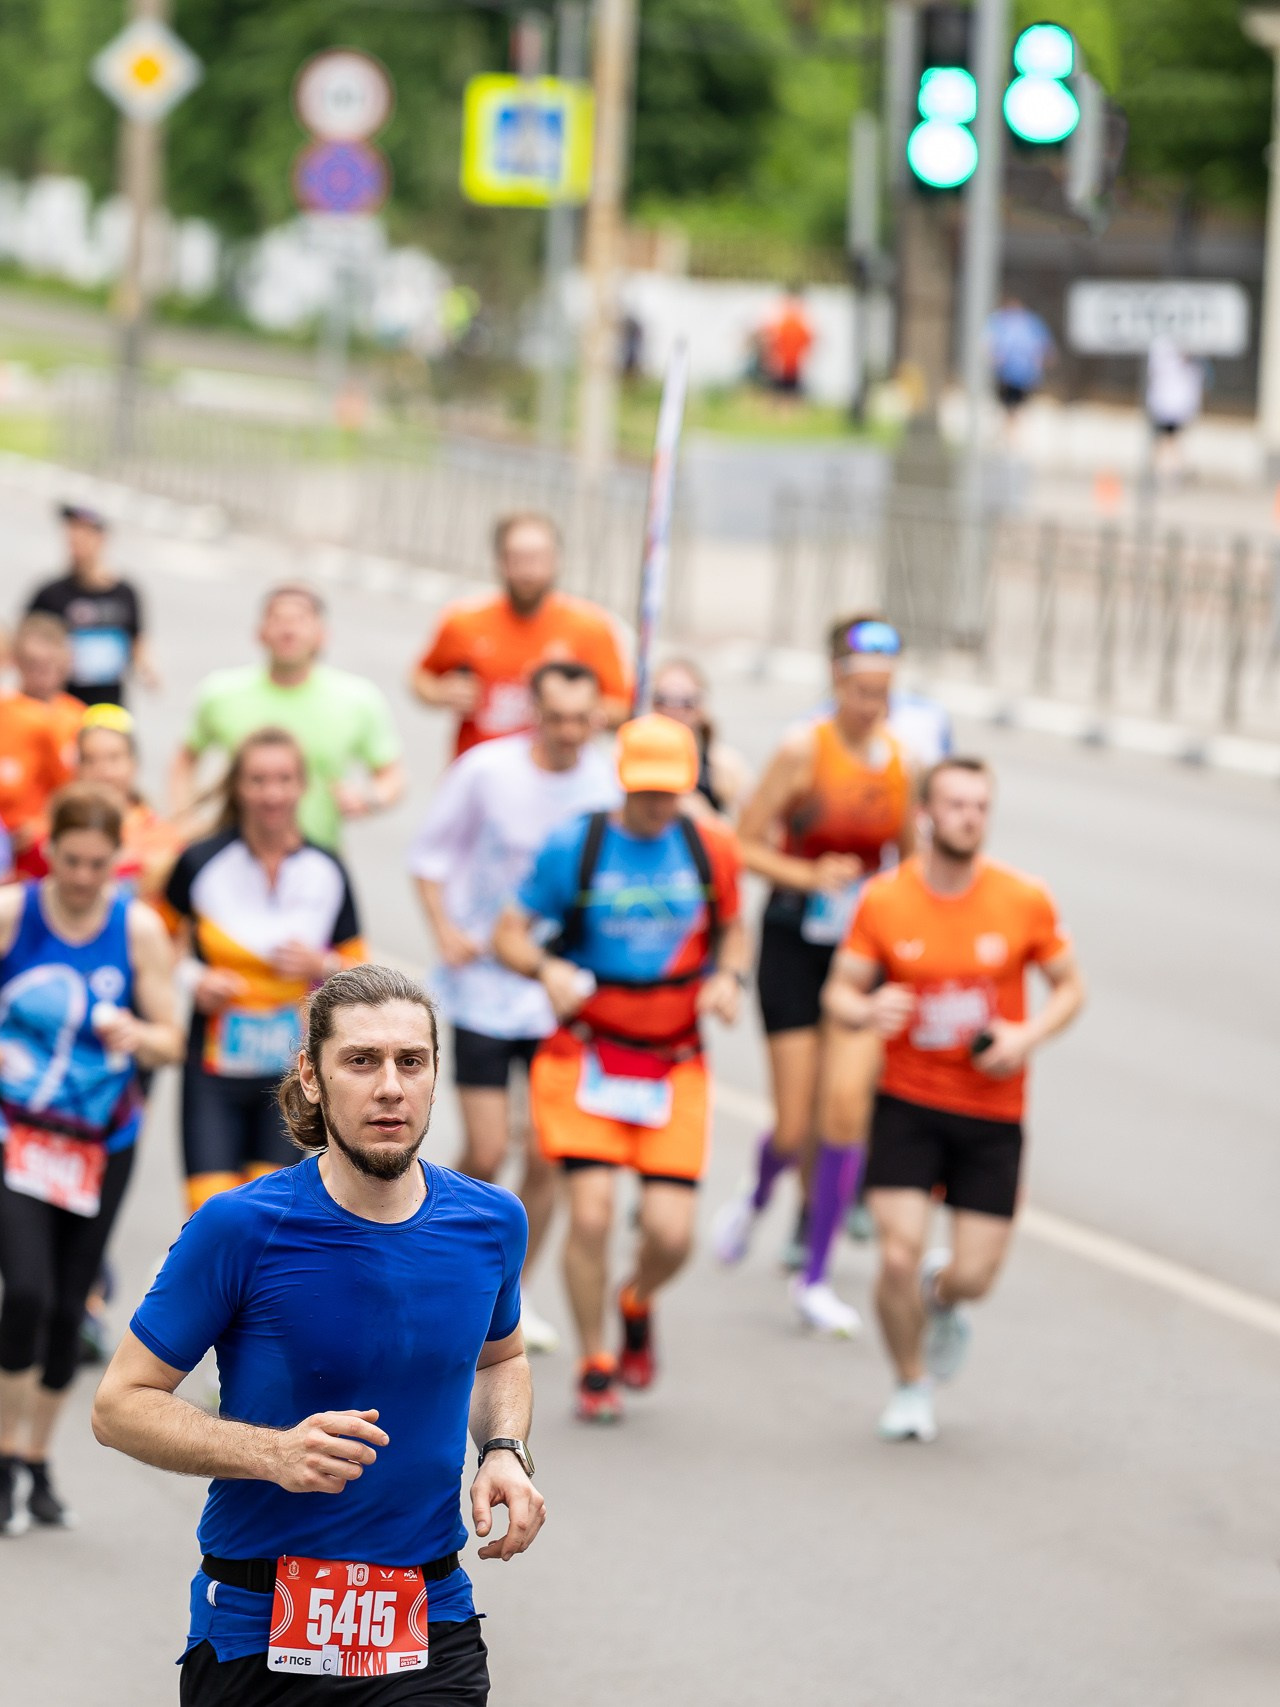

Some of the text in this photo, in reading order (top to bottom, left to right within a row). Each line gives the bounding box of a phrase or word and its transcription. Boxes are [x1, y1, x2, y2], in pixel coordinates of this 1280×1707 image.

[345, 1563, 370, 1587] 10
[306, 1587, 398, 1648] 5415
[289, 1656, 312, 1666] ПСБ
